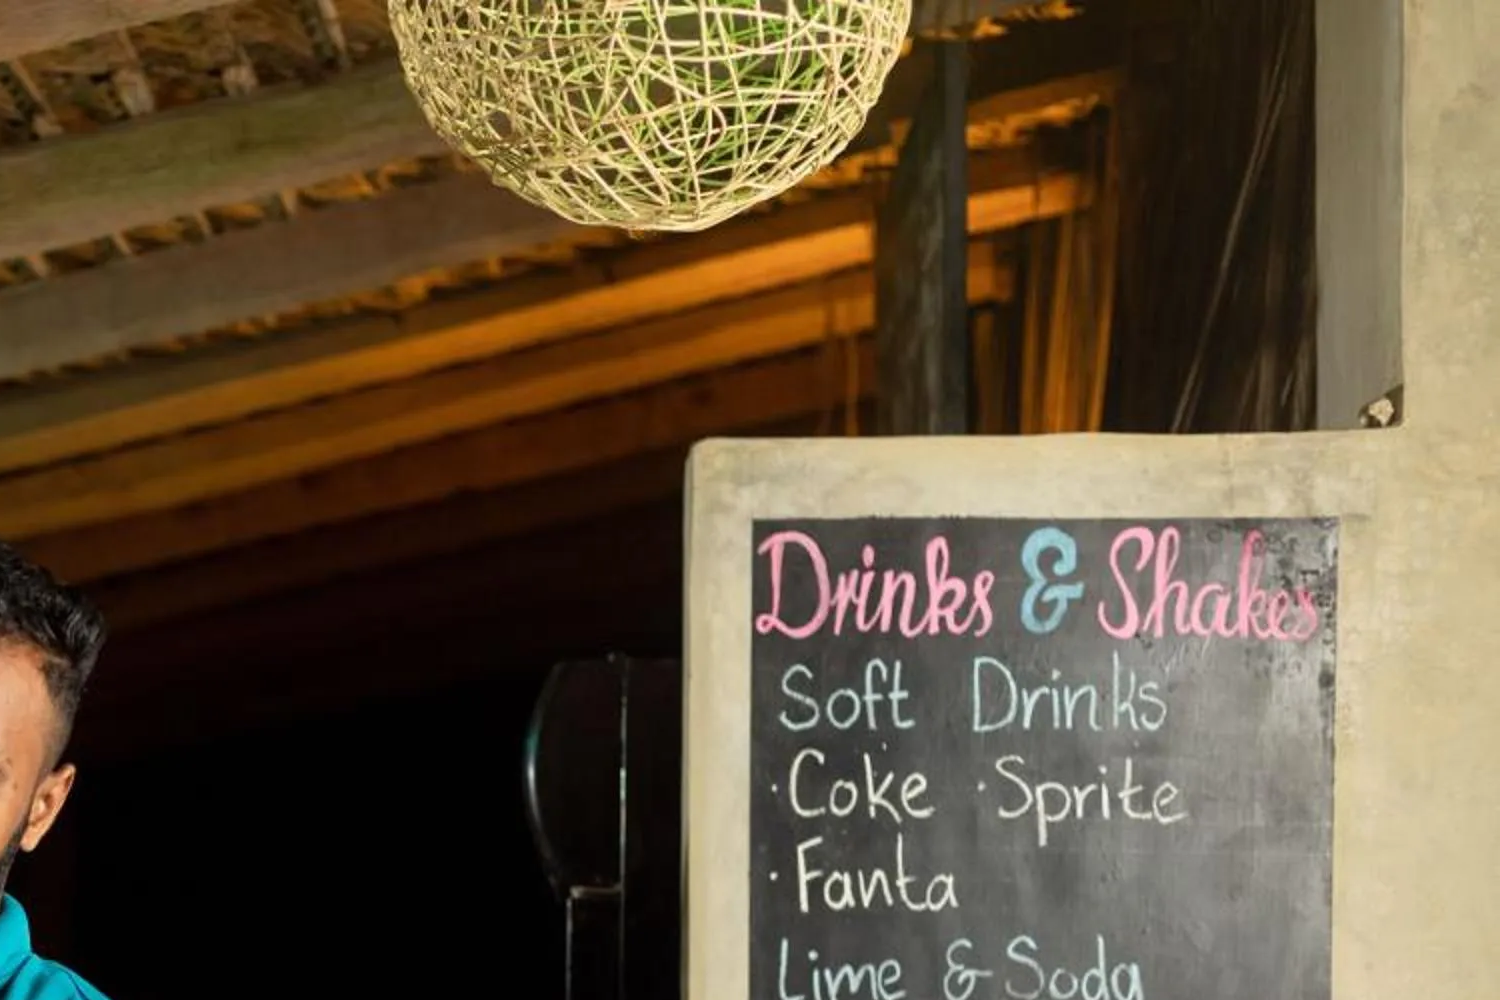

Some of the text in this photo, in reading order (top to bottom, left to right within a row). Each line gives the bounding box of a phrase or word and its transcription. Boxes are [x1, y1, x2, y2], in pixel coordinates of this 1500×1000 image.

[756, 525, 1319, 642] Drinks & Shakes
[779, 650, 1168, 733] Soft Drinks
[789, 748, 1189, 846] Coke Sprite
[796, 834, 959, 912] Fanta
